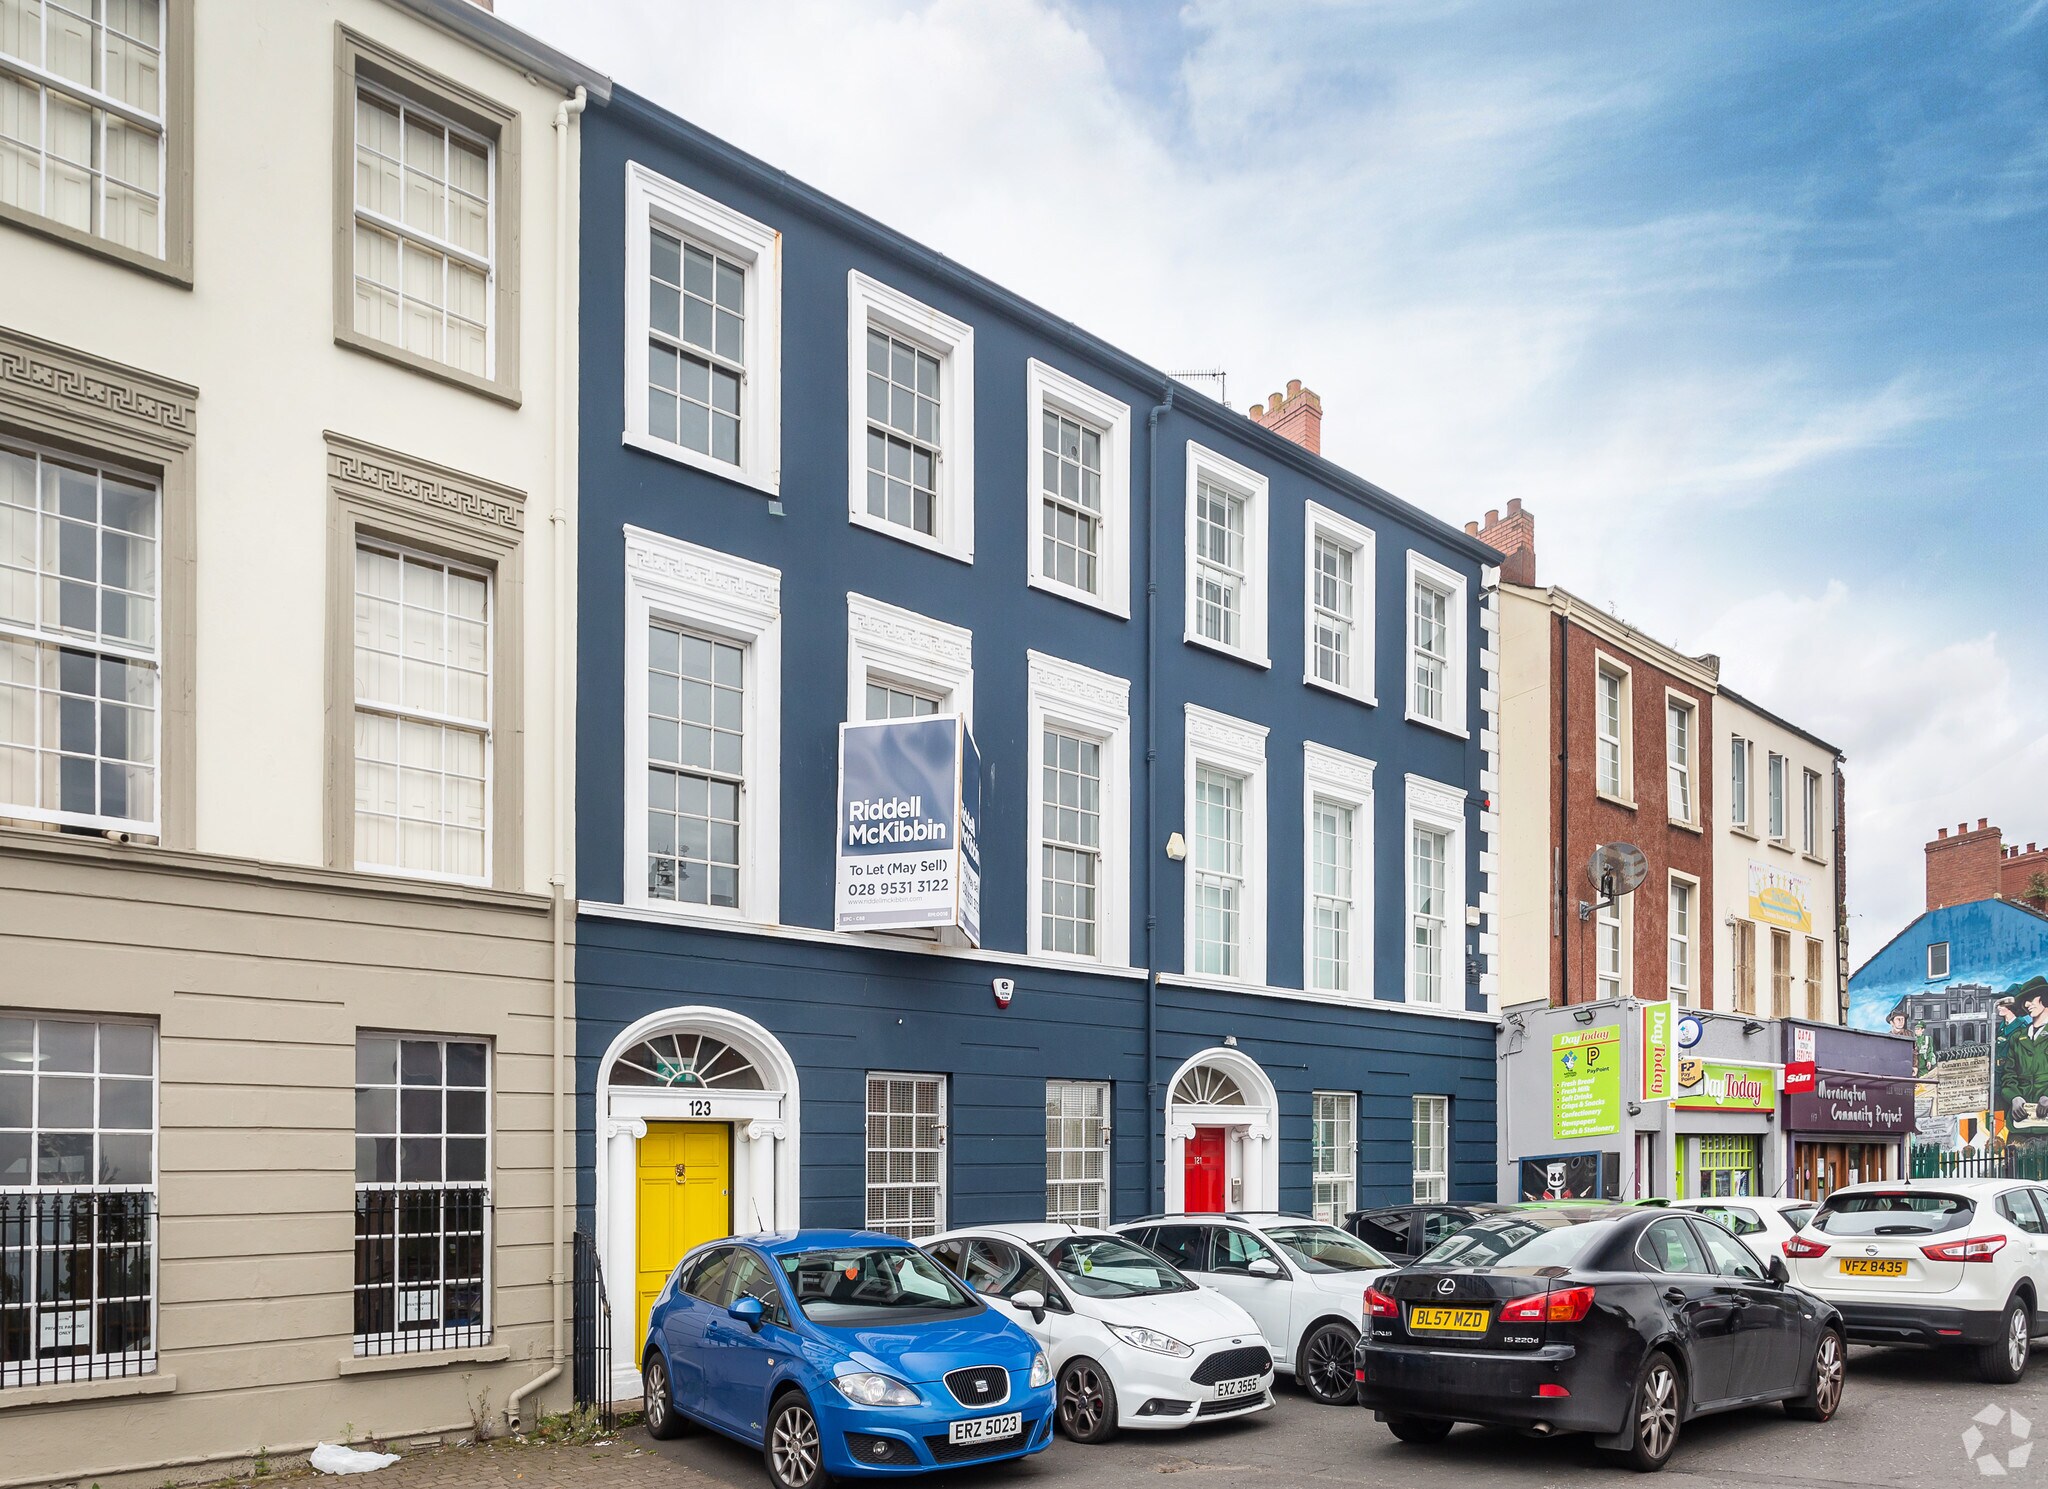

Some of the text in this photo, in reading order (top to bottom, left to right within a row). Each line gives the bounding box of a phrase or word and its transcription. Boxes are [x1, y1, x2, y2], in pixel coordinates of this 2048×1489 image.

[849, 796, 921, 822] Riddell
[849, 818, 946, 846] McKibbin
[850, 859, 947, 876] To Let (May Sell)
[848, 878, 949, 896] 028 9531 3122
[1561, 1077, 1595, 1088] Fresh Bread
[1786, 1073, 1811, 1083] Sun
[1561, 1085, 1590, 1095] Fresh Milk
[1818, 1080, 1867, 1107] Mornington
[1561, 1093, 1593, 1103] Soft Drinks
[1584, 1099, 1605, 1107] Snacks
[689, 1100, 711, 1116] 123
[1561, 1109, 1602, 1119] Confectionery
[1831, 1102, 1873, 1128] Community
[1875, 1104, 1903, 1128] Project
[1561, 1118, 1597, 1127] Newspapers
[1561, 1128, 1578, 1136] Cards
[1584, 1125, 1615, 1134] Stationery
[1194, 1156, 1202, 1165] 121
[1845, 1260, 1903, 1273] VFZ 8435
[1417, 1310, 1482, 1328] BL57 MZD
[1218, 1377, 1257, 1397] EXZ 3555
[955, 1421, 982, 1440] ERZ
[985, 1416, 1017, 1436] 5023
